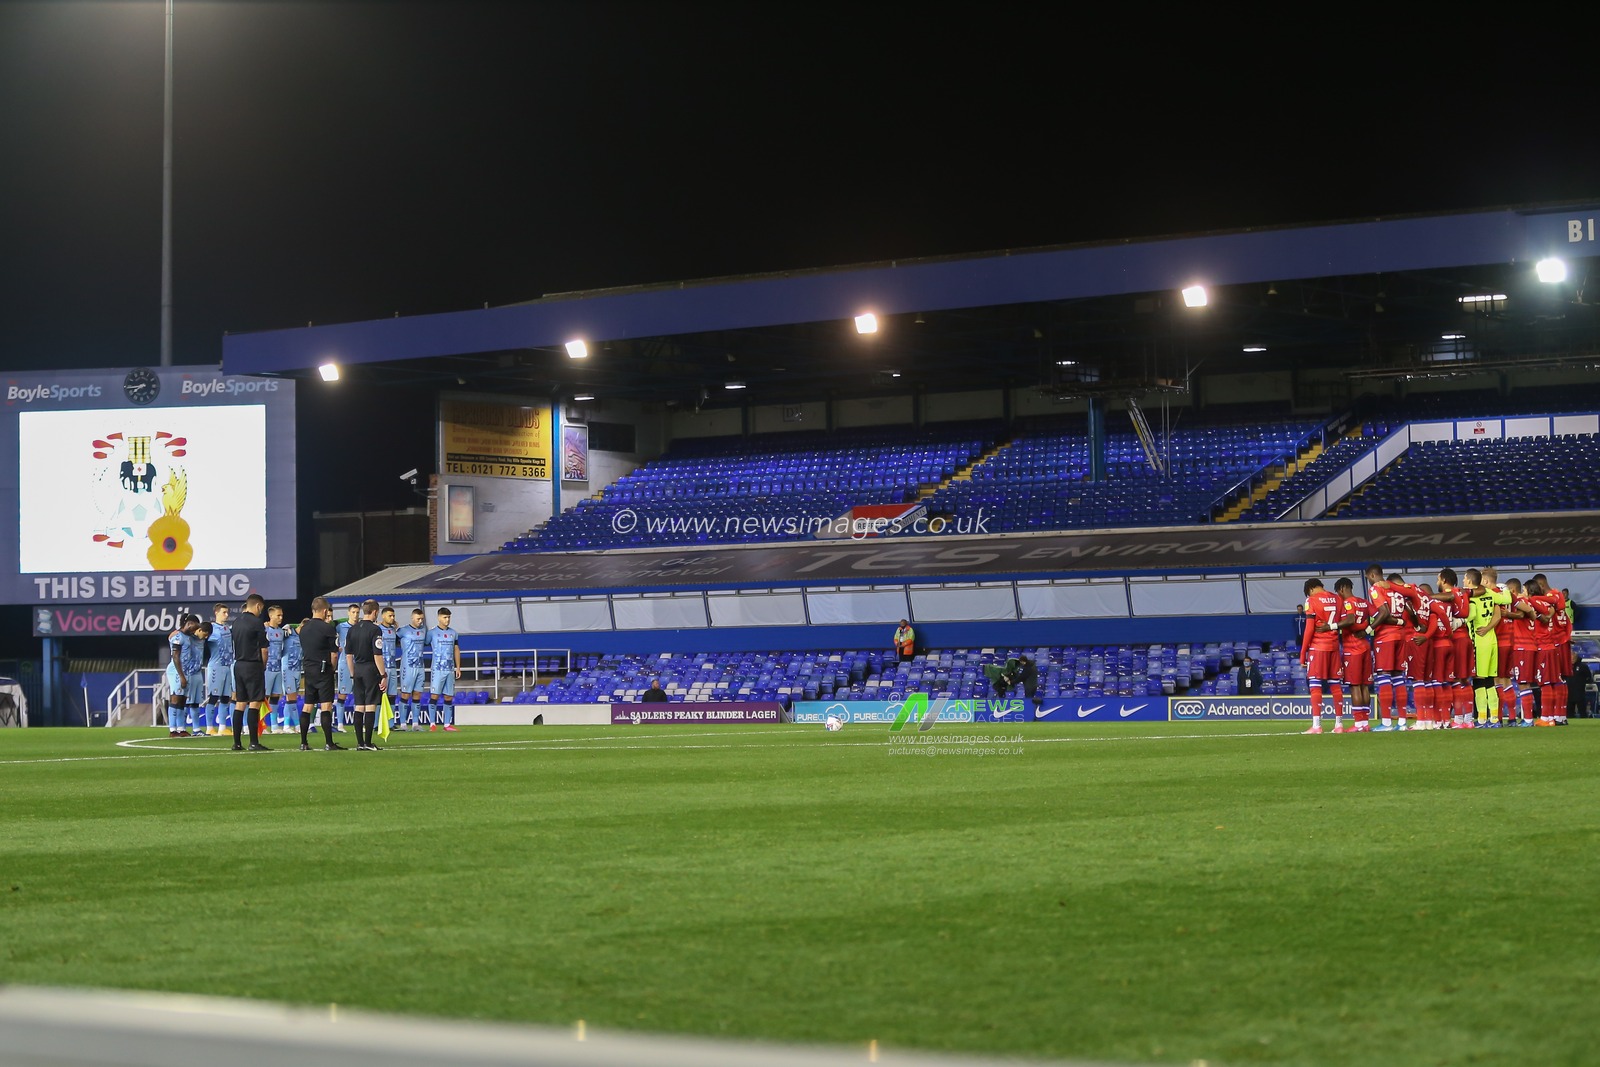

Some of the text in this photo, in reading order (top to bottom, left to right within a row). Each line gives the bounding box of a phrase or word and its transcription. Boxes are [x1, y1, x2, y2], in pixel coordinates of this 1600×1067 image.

[7, 384, 102, 403] BoyleSports
[181, 378, 280, 397] BoyleSports
[499, 465, 517, 476] 772
[522, 467, 546, 477] 5366
[795, 532, 1476, 573] TES ENVIRONMENTAL
[435, 571, 582, 583] Asbestos
[34, 576, 96, 599] THIS
[102, 576, 127, 598] IS
[1324, 606, 1337, 628] 7
[630, 710, 777, 720] SADLER'S PEAKY BLINDER LAGER
[1207, 702, 1270, 716] Advanced
[1272, 702, 1313, 715] Colour
